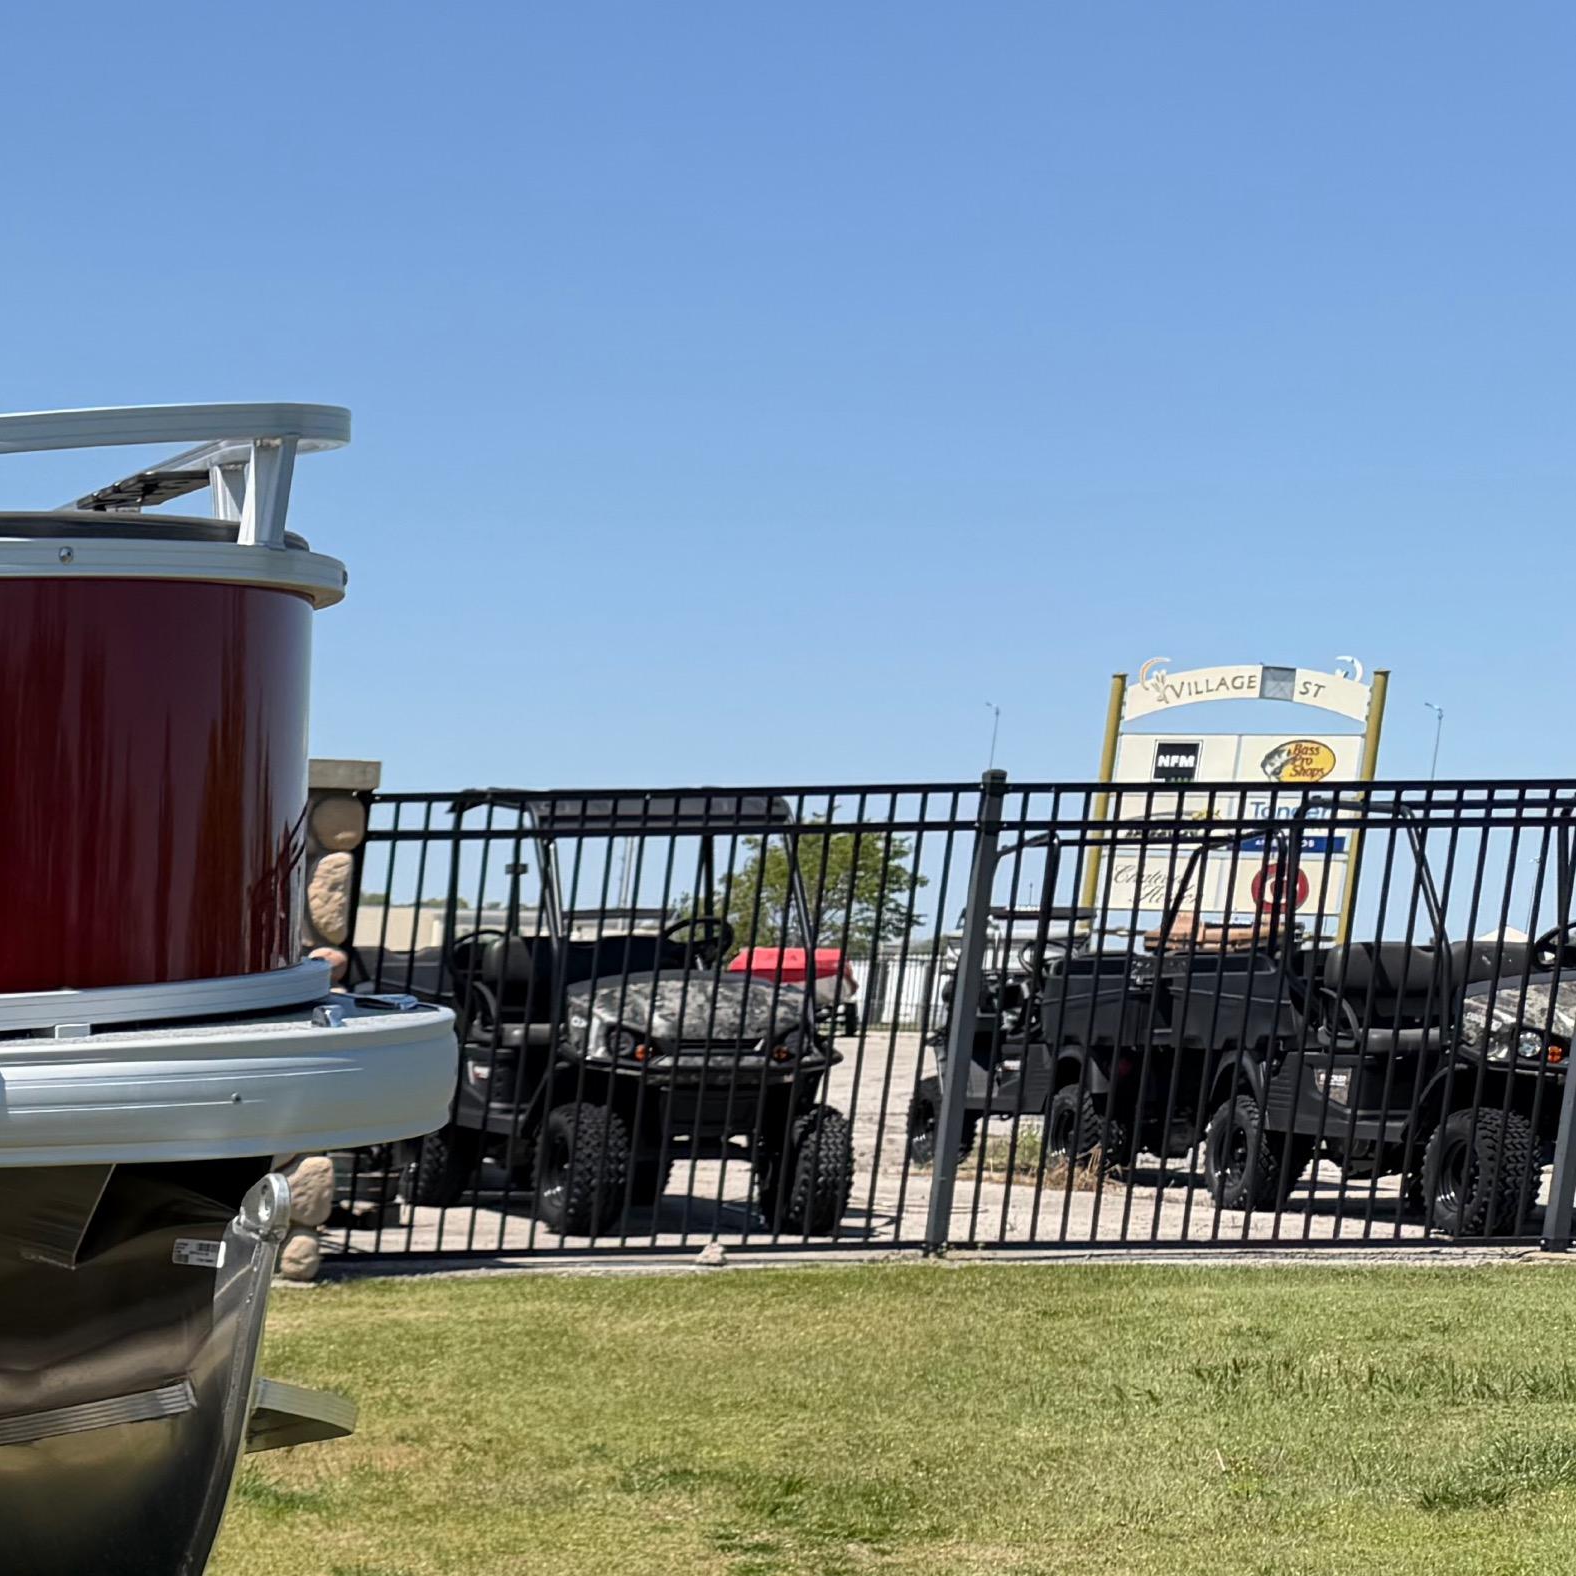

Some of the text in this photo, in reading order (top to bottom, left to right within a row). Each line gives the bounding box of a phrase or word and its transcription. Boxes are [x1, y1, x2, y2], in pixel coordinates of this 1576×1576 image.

[1167, 674, 1326, 699] VILLAGE ST
[1292, 743, 1321, 756] Bass
[1158, 754, 1196, 768] NFM
[1291, 755, 1314, 766] Pro
[1290, 765, 1325, 778] Shops
